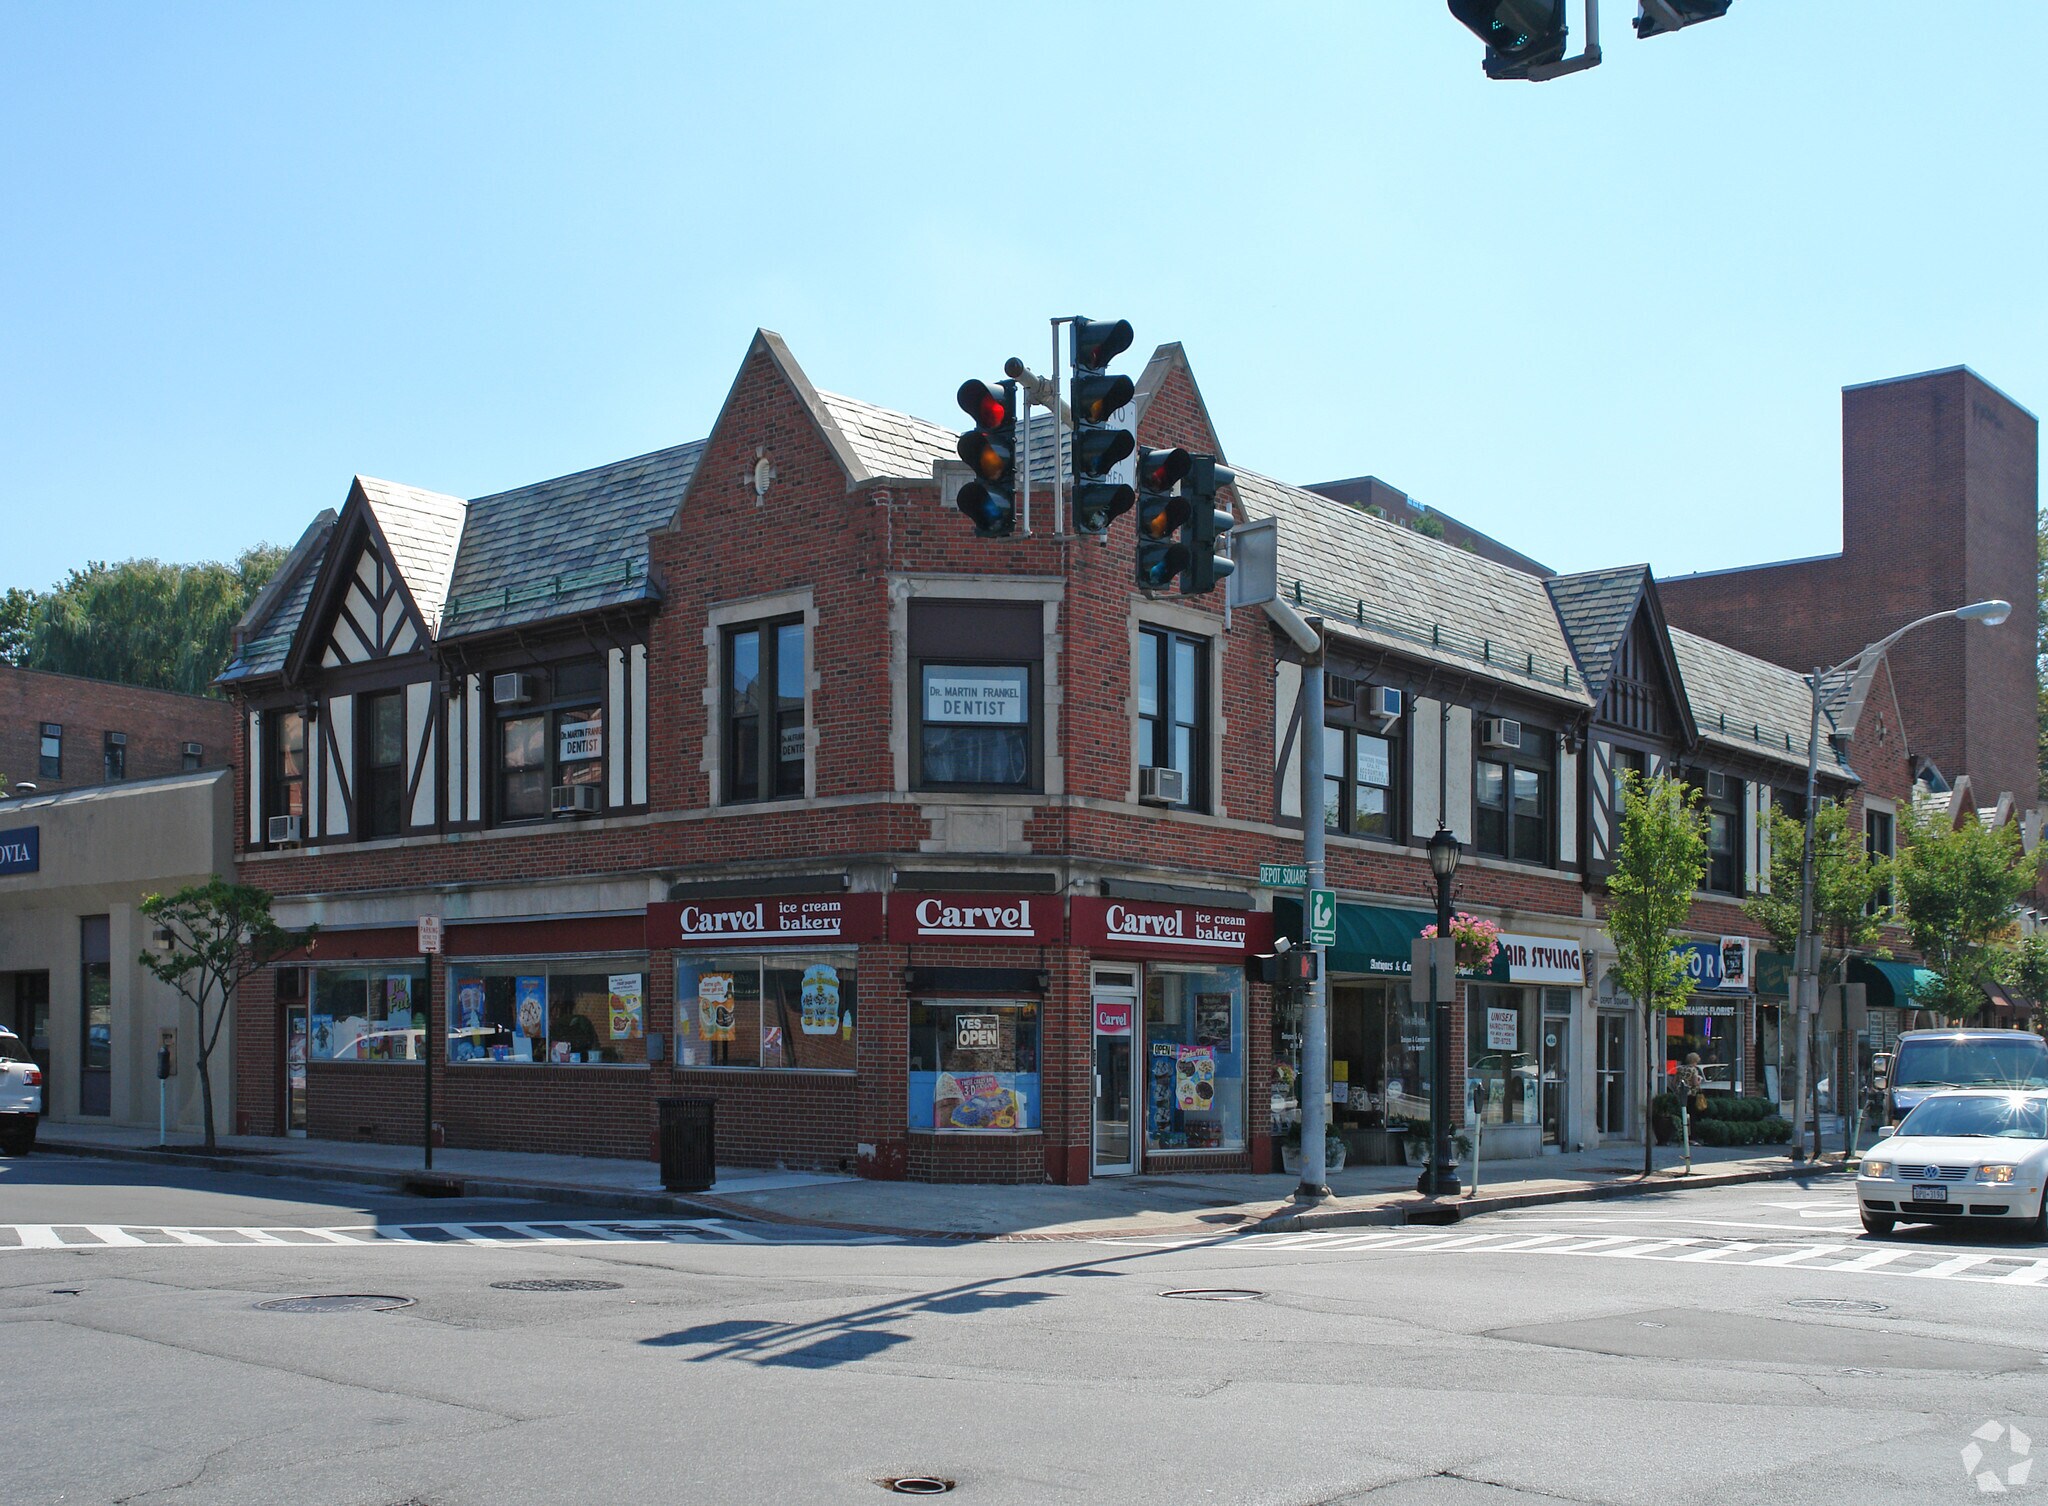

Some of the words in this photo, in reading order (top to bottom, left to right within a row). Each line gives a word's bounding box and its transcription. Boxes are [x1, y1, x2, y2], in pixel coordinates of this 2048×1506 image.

[945, 687, 978, 697] MARTIN
[983, 688, 1019, 698] FRANKEL
[943, 700, 1006, 716] DENTIST
[567, 728, 585, 739] MARTIN
[567, 739, 598, 754] DENTIST
[1260, 866, 1281, 883] DEPOT
[1282, 868, 1307, 885] SQUARE
[680, 903, 764, 932] Carvel
[779, 902, 797, 913] ice
[801, 902, 841, 912] cream
[916, 899, 1031, 928] Carvel
[1106, 904, 1183, 936] Carvel
[1195, 911, 1211, 923] ice
[1214, 914, 1246, 926] cream
[779, 914, 841, 930] bakery
[420, 926, 439, 934] PARKING
[1195, 924, 1246, 942] bakery
[1531, 946, 1580, 970] STYLING
[1491, 1011, 1513, 1022] UNISEX
[1709, 1005, 1735, 1016] FLORIST
[959, 1018, 981, 1029] YES
[1100, 1011, 1127, 1026] Carvel
[1489, 1022, 1515, 1031] HAIRCUTTING
[959, 1030, 997, 1046] OPEN
[1155, 1045, 1171, 1055] OPEN
